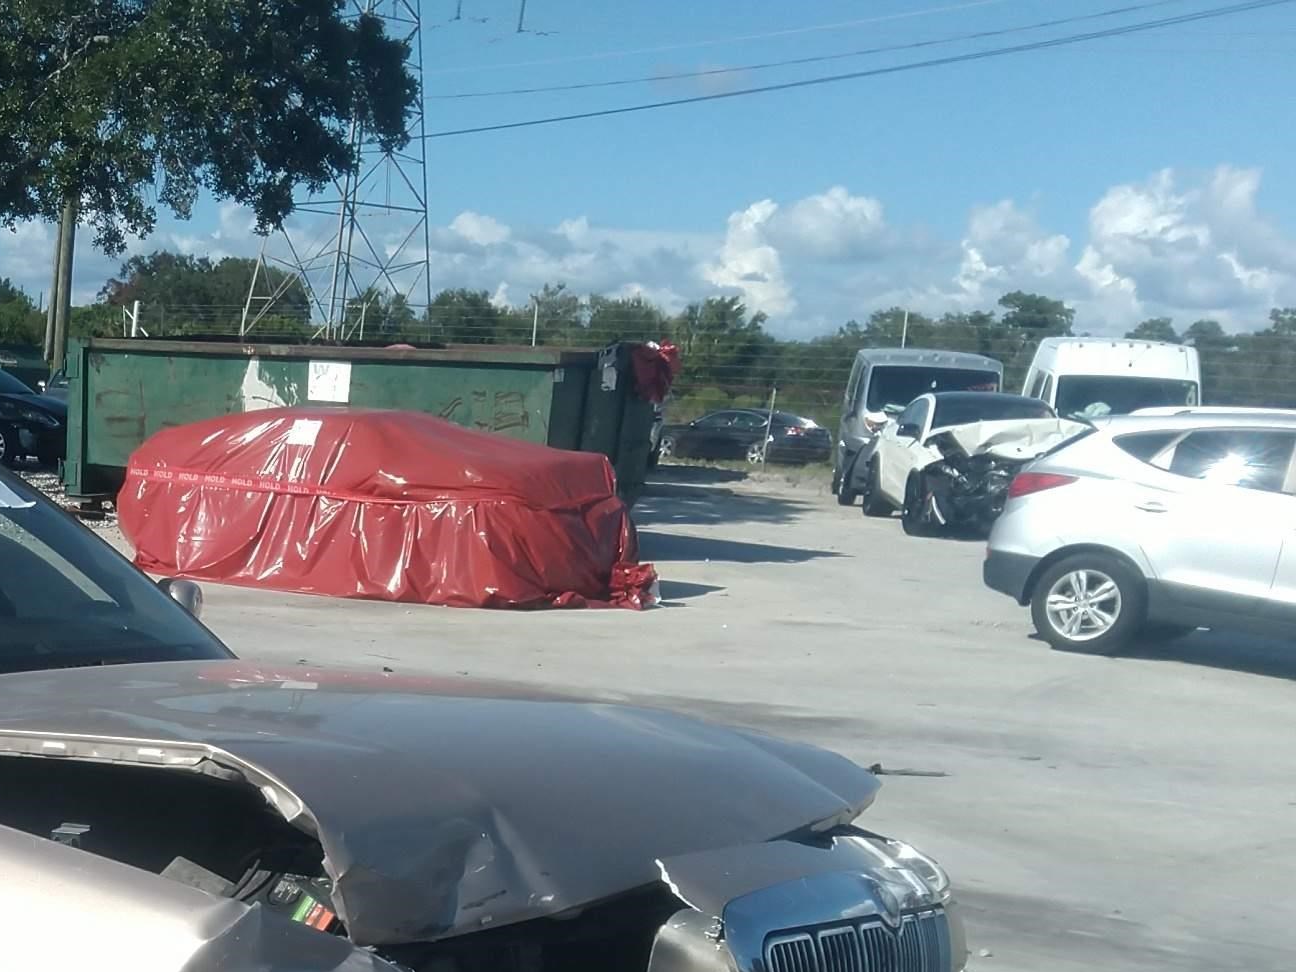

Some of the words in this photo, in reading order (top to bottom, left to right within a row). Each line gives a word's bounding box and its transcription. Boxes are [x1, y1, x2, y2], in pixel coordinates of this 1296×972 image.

[153, 470, 173, 479] HOLD
[178, 472, 199, 481] HOLD
[204, 474, 225, 484] HOLD
[231, 478, 253, 487] HOLD
[259, 482, 281, 490] HOLD
